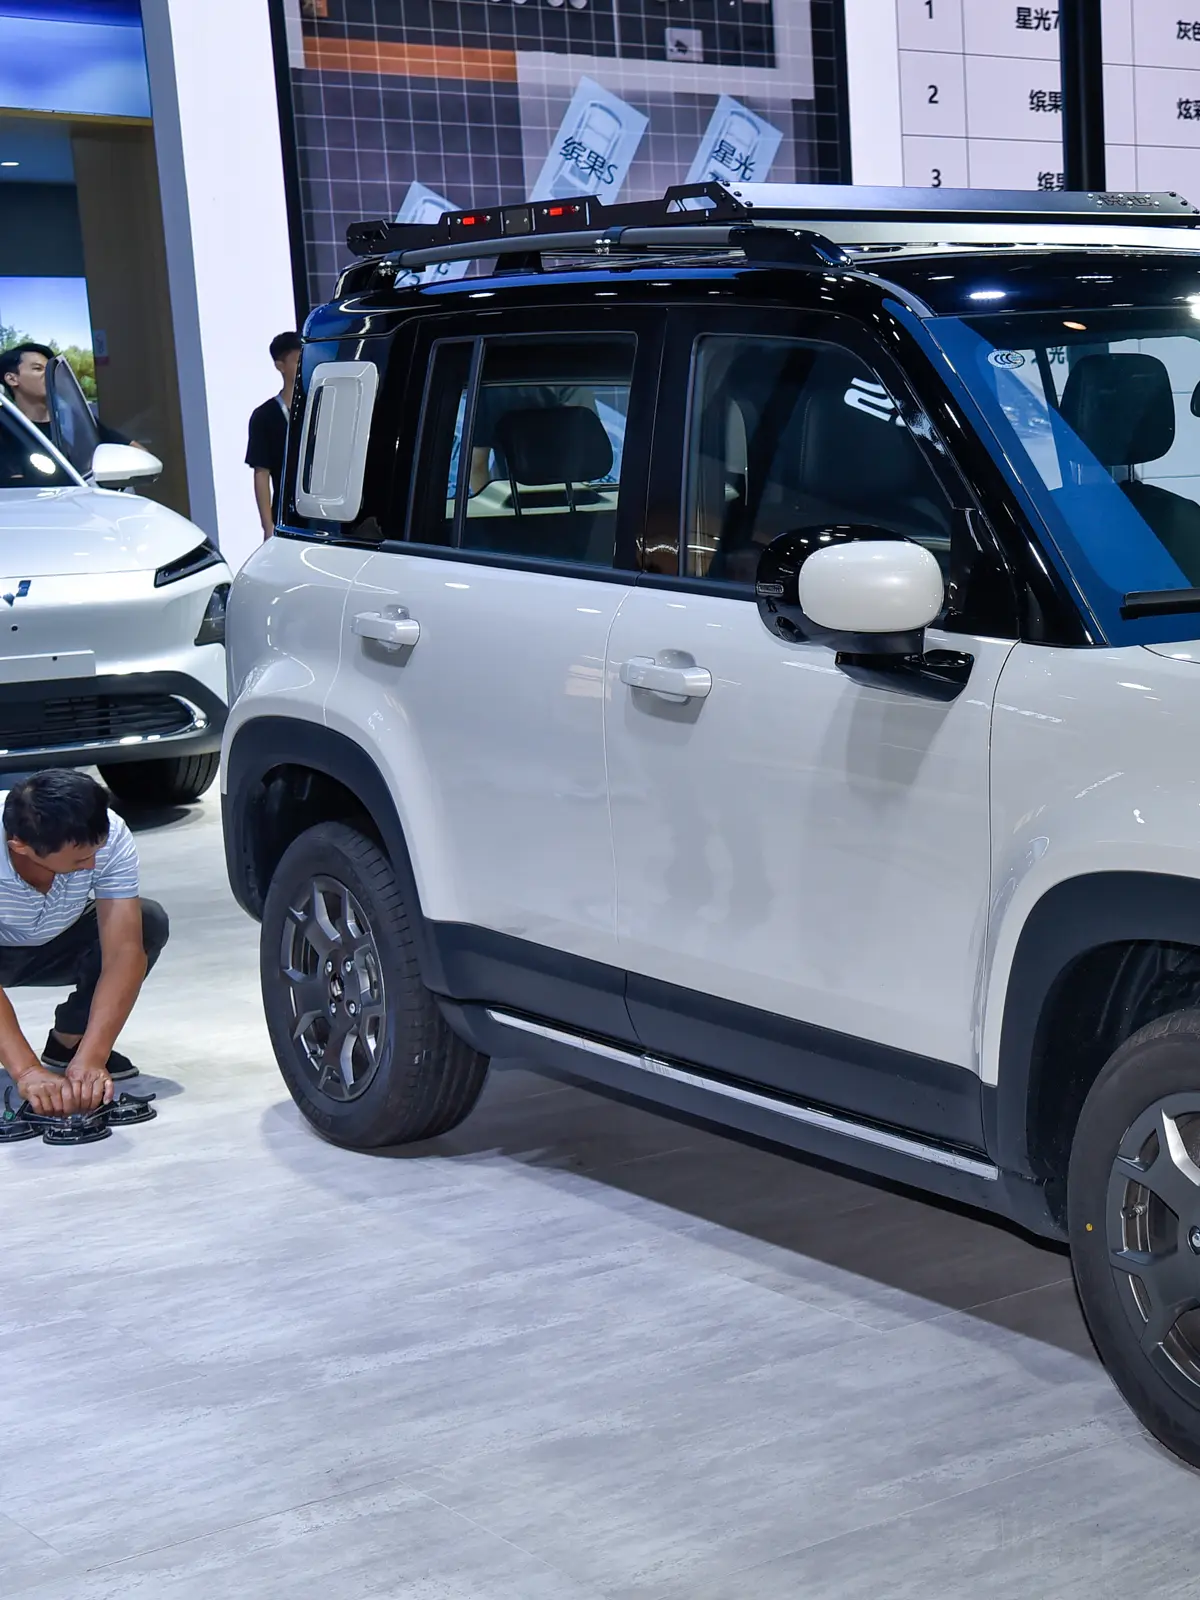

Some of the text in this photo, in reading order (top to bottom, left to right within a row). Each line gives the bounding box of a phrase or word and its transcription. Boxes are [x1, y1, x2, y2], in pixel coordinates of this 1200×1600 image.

[924, 0, 934, 19] 1
[927, 84, 939, 104] 2
[560, 135, 619, 185] 缤果S
[711, 138, 757, 181] 星光
[931, 168, 942, 188] 3
